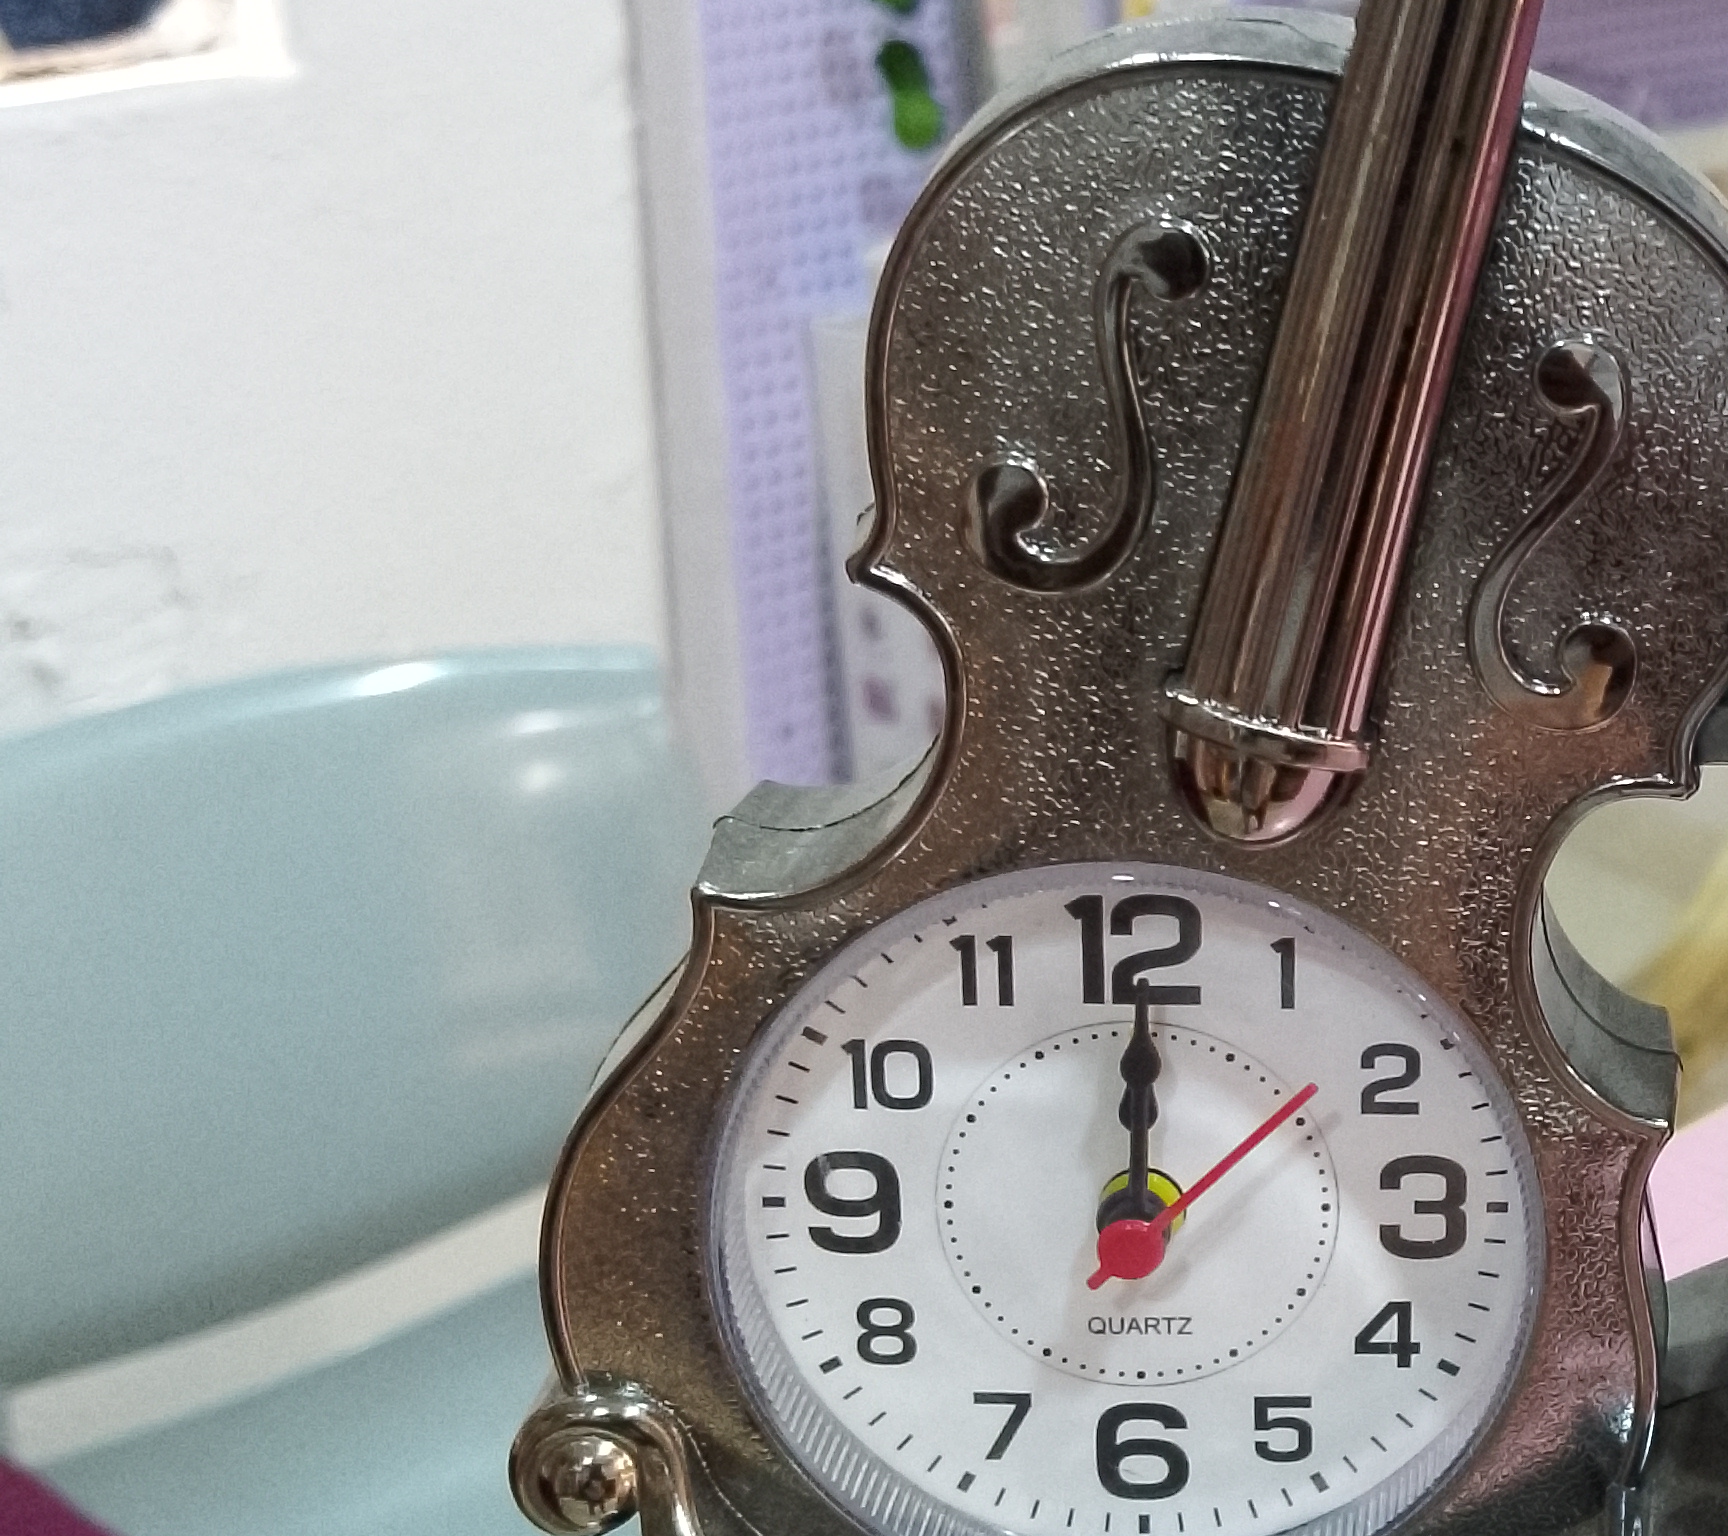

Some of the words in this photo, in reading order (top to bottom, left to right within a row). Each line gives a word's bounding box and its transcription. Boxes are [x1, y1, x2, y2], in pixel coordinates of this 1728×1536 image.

[949, 934, 1014, 1006] 11
[1063, 894, 1203, 1006] 12
[1269, 937, 1297, 1010] 1
[841, 1039, 933, 1111] 10
[1360, 1042, 1421, 1115] 2
[803, 1151, 902, 1255] 9
[1379, 1155, 1467, 1260] 3
[856, 1297, 916, 1365] 8
[1087, 1316, 1194, 1336] QUARTZ
[1354, 1300, 1421, 1369] 4
[973, 1392, 1032, 1461] 7
[1095, 1402, 1190, 1500] 6
[1253, 1396, 1313, 1463] 5
